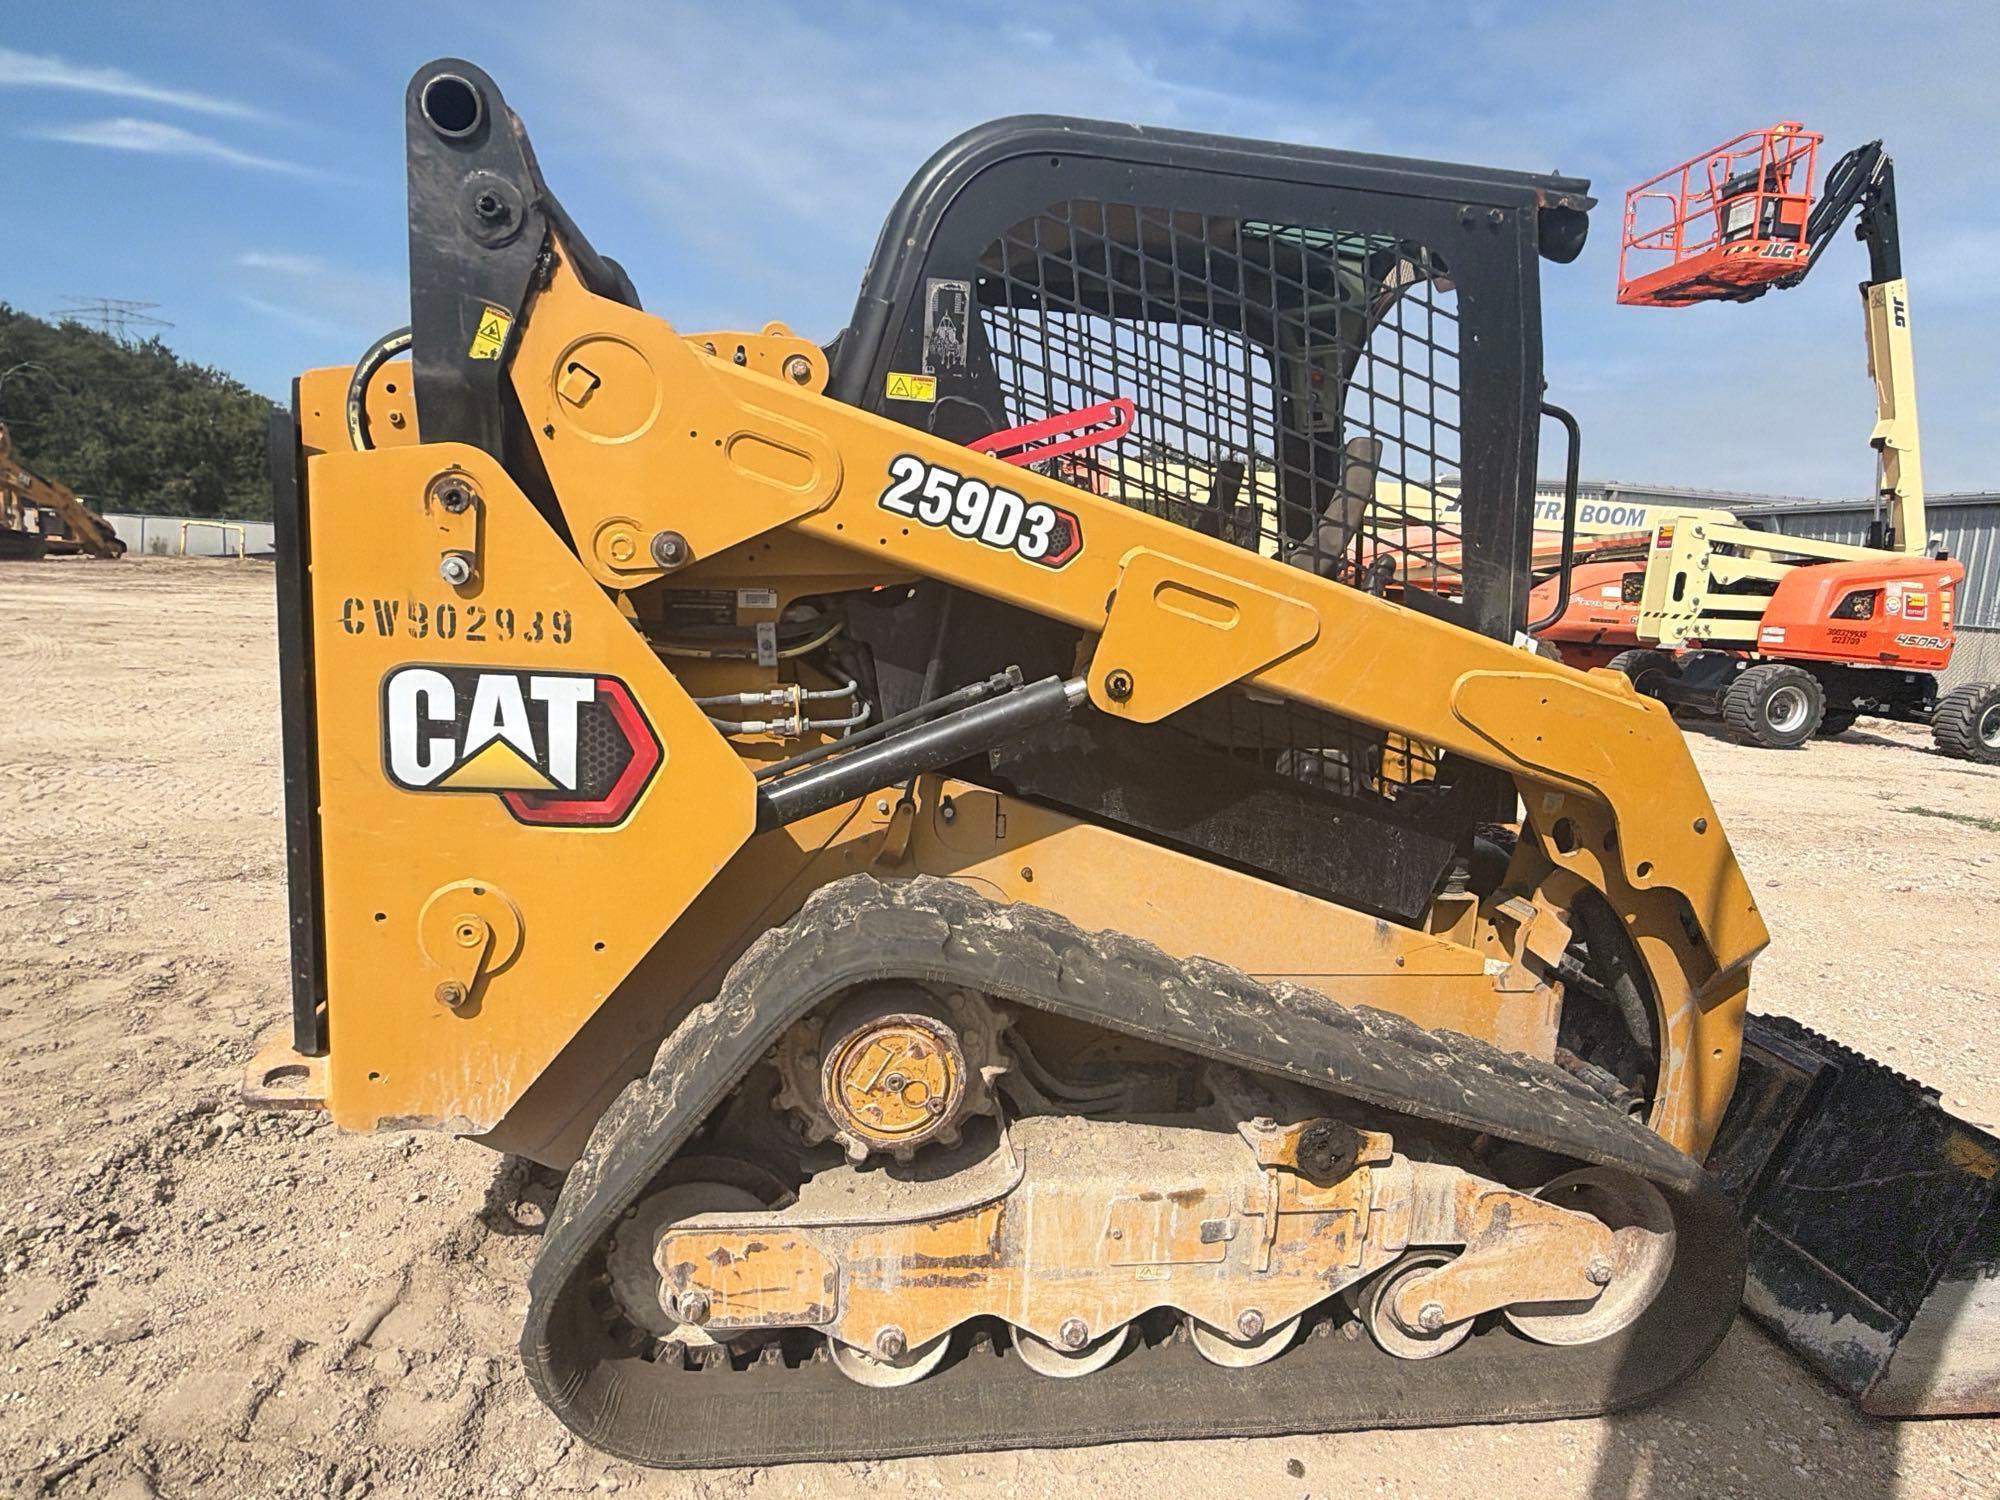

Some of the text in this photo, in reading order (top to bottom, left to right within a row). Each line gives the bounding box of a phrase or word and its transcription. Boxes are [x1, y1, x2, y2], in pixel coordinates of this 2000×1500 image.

[1760, 243, 1795, 258] JLG
[1893, 296, 1906, 327] JLG
[881, 456, 1057, 559] 259D3
[1579, 504, 1646, 527] BOOM
[342, 598, 572, 644] CW902939
[1896, 634, 1949, 649] 450AJ
[388, 668, 595, 790] CAT
